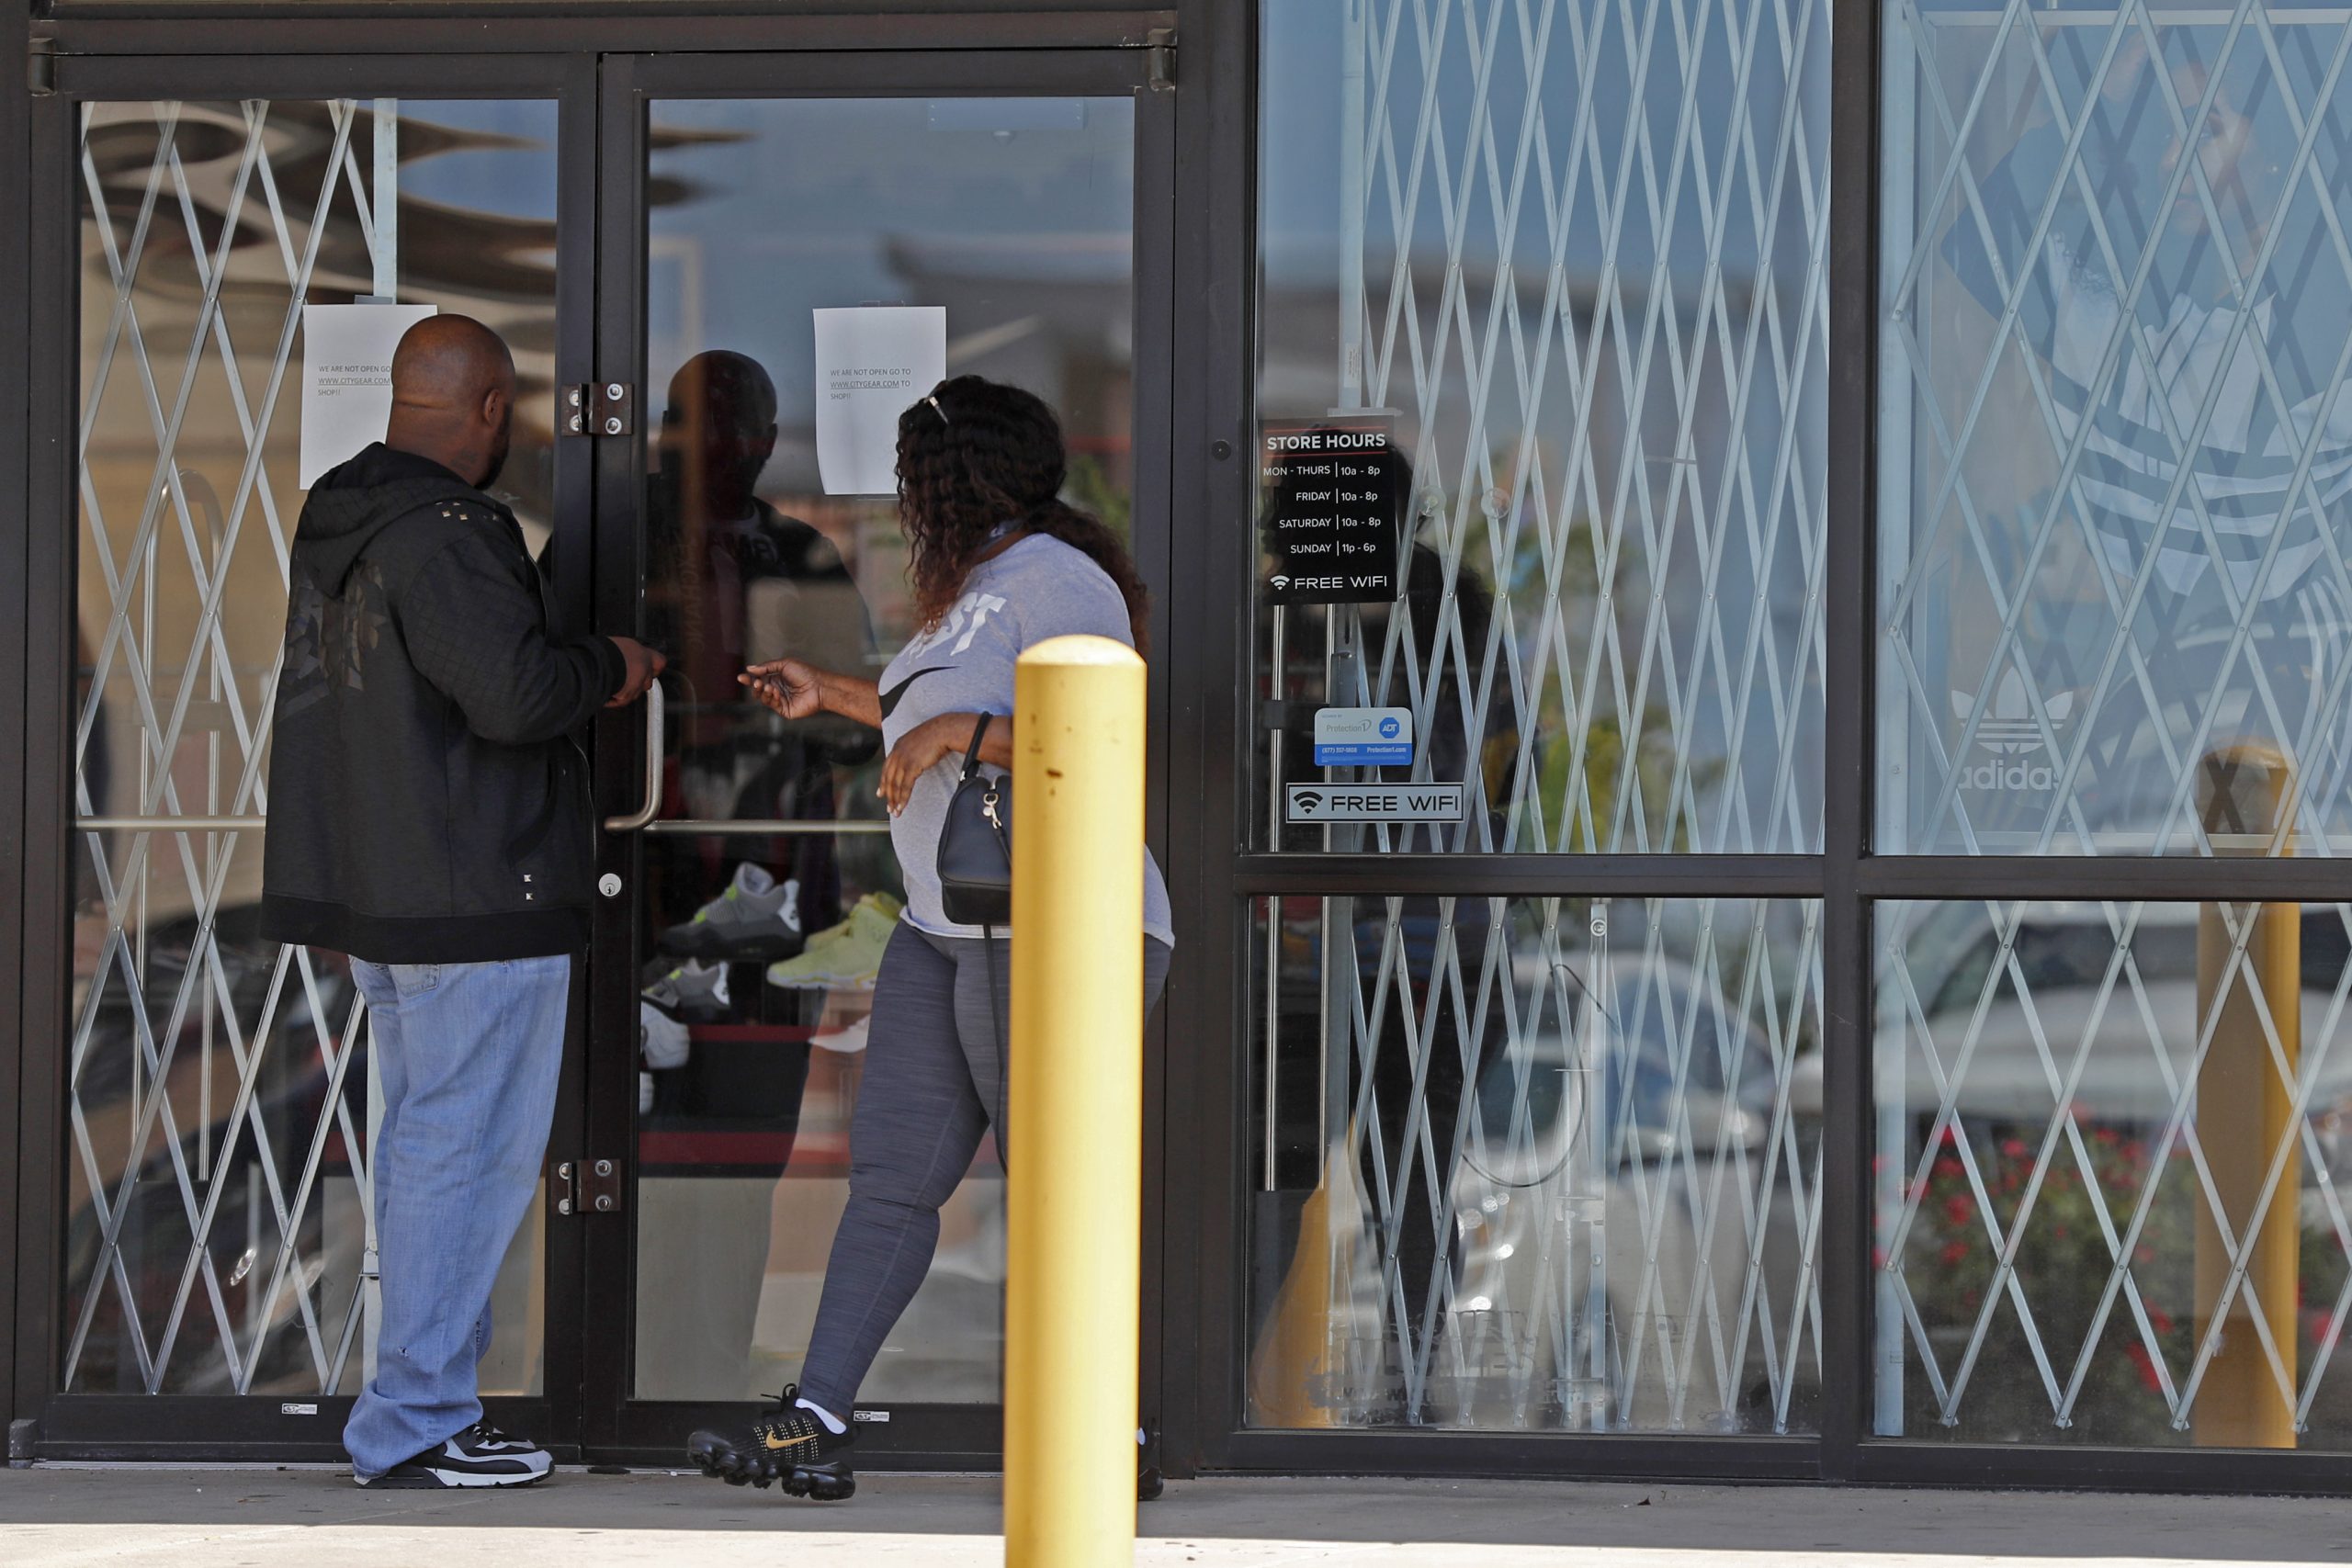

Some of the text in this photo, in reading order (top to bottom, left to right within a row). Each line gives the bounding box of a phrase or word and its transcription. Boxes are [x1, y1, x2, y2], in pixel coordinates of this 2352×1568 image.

[1267, 434, 1385, 450] STORE HOURS
[1263, 467, 1287, 476] MON
[1296, 466, 1331, 475] THURS
[1340, 467, 1357, 476] 10a
[1367, 466, 1381, 477] 8p
[1295, 491, 1331, 502] FRIDAY
[1340, 492, 1357, 501] 10a
[1365, 491, 1378, 502] 8p
[1279, 518, 1331, 528] SATURDAY
[1341, 518, 1358, 526] 10a
[1368, 517, 1381, 528] 8p
[1290, 544, 1331, 554] SUNDAY
[1341, 544, 1355, 554] 11p
[1363, 543, 1376, 553] 6p
[1295, 575, 1387, 590] FREE WIFI
[1382, 724, 1397, 732] ADT
[1331, 795, 1458, 812] FREE WIFI
